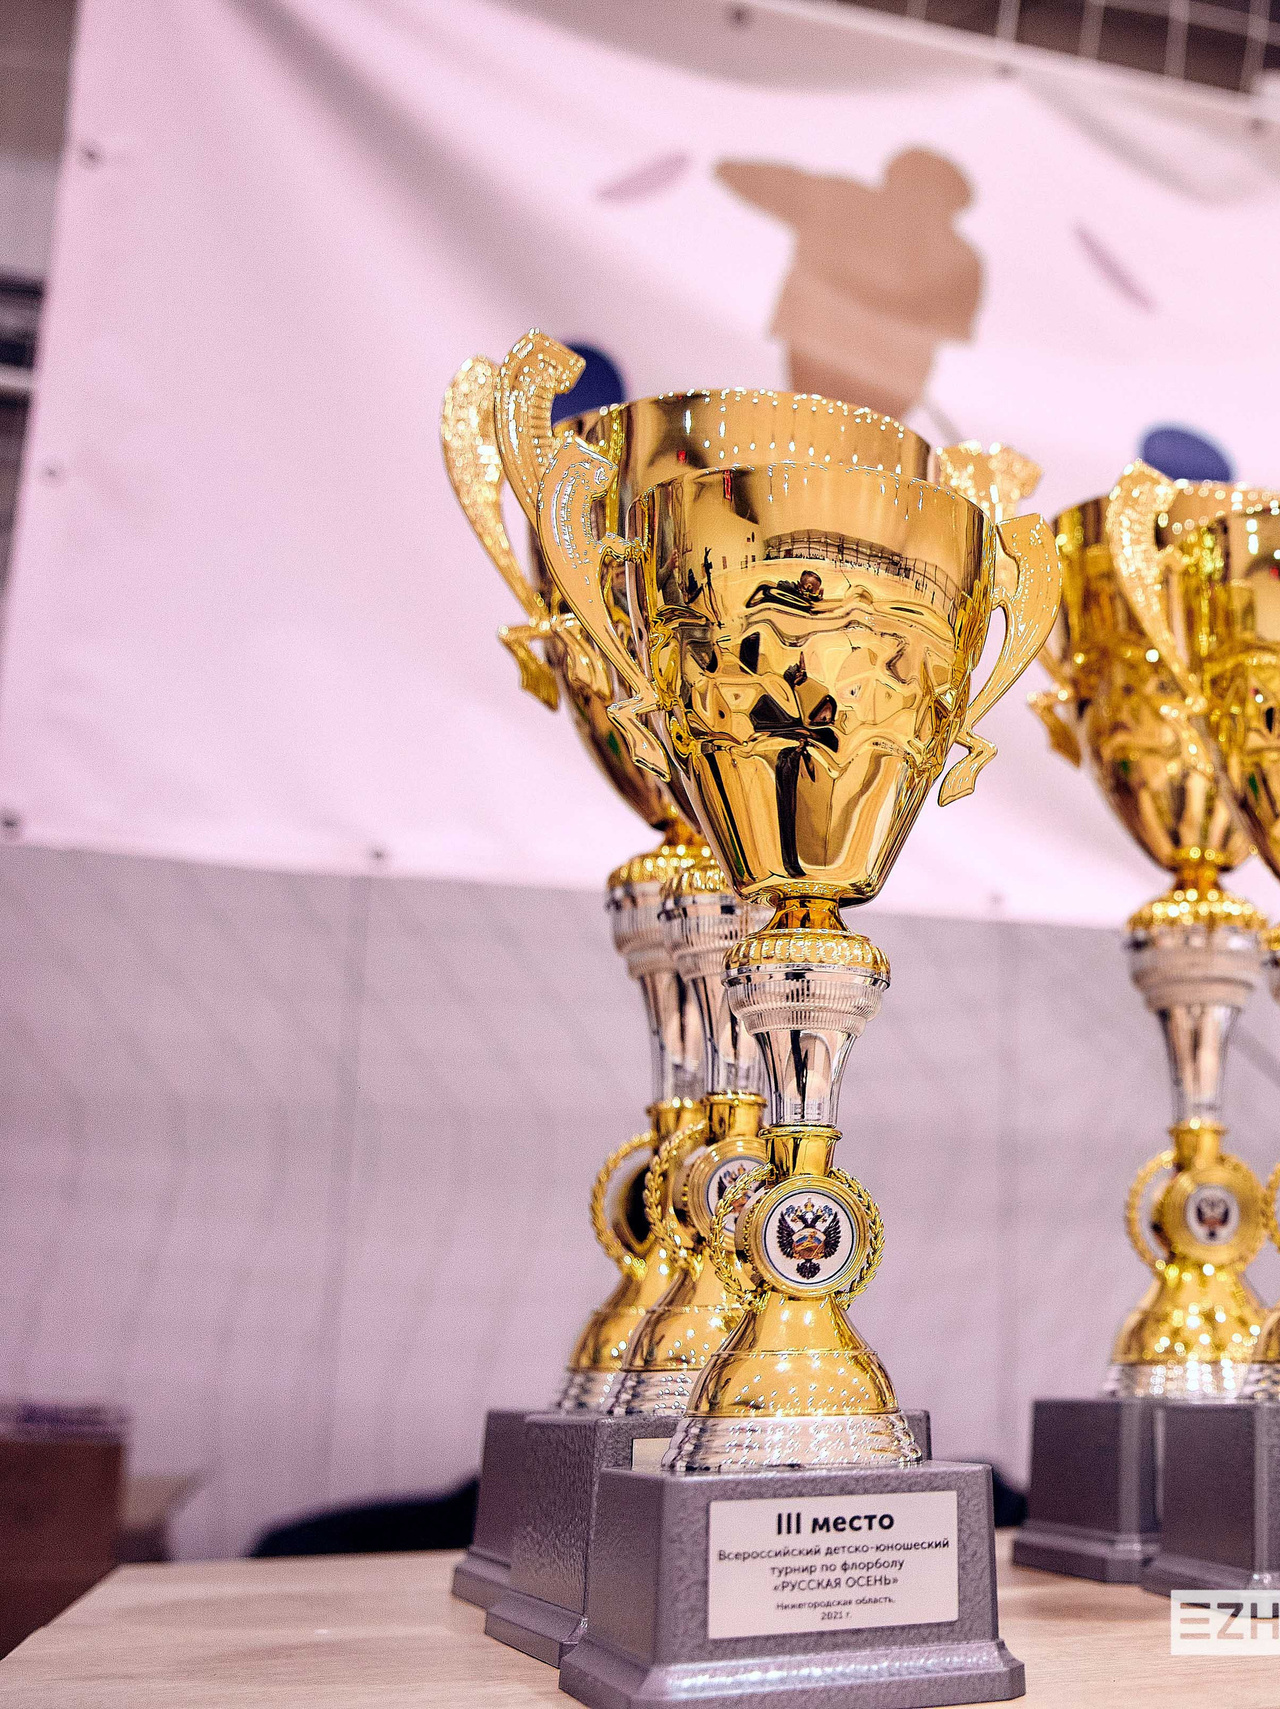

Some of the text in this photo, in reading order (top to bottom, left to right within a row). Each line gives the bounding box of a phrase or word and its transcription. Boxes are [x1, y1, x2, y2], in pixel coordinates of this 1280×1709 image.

[777, 1512, 894, 1535] III место
[718, 1538, 950, 1562] Всероссийский детско-юношеский
[770, 1558, 905, 1577] турнир по флорболу
[773, 1575, 899, 1591] «РУССКАЯ ОСЕНЬ»
